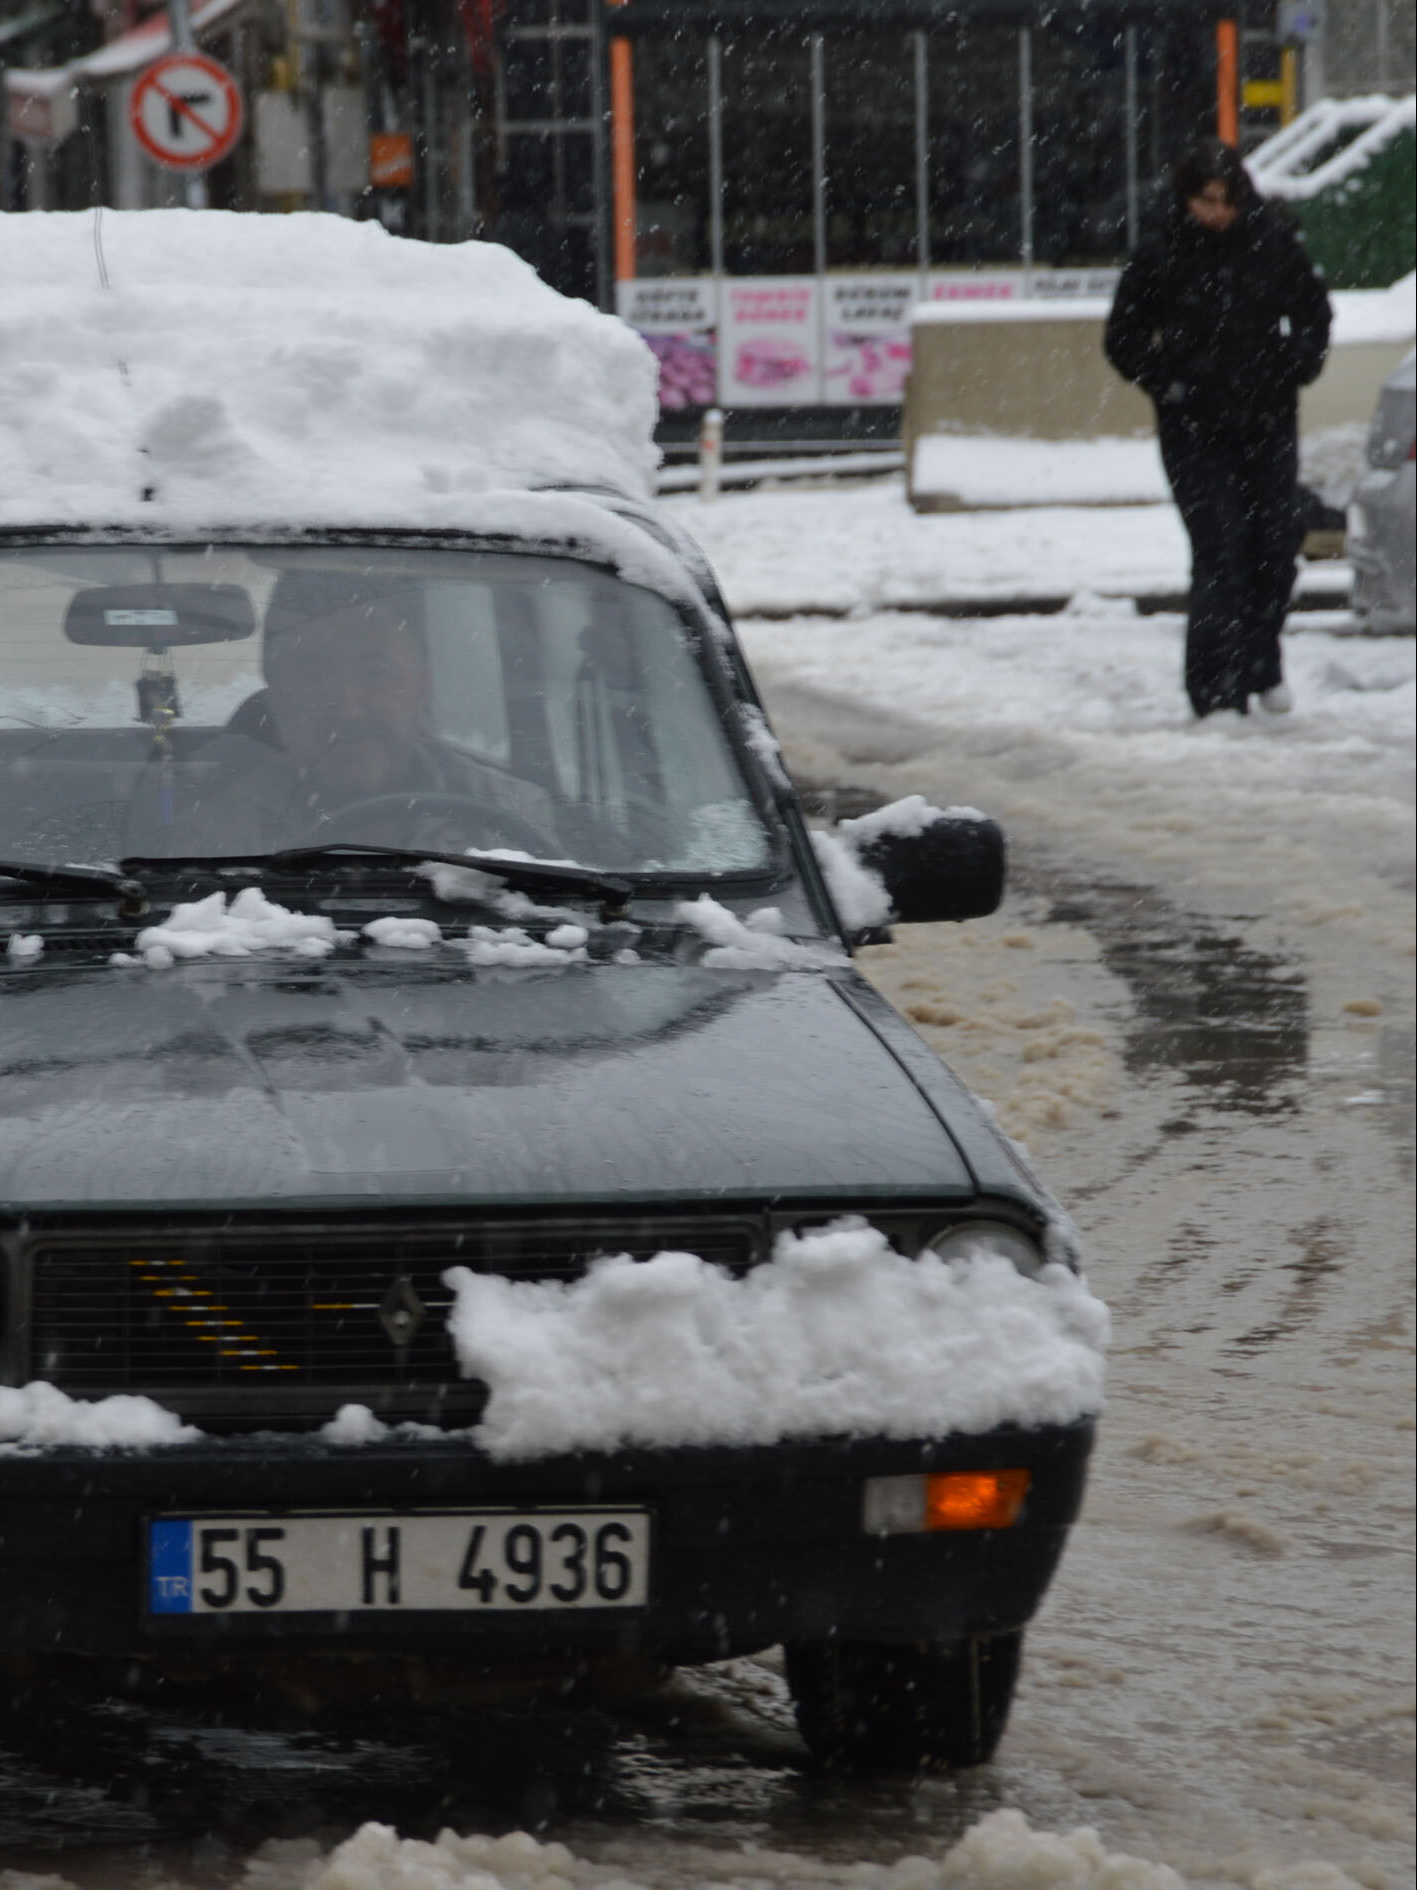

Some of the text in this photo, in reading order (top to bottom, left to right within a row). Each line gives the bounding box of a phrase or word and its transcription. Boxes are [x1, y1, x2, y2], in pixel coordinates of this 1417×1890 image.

[156, 1576, 190, 1598] TR
[200, 1522, 633, 1608] 55 H 4936
